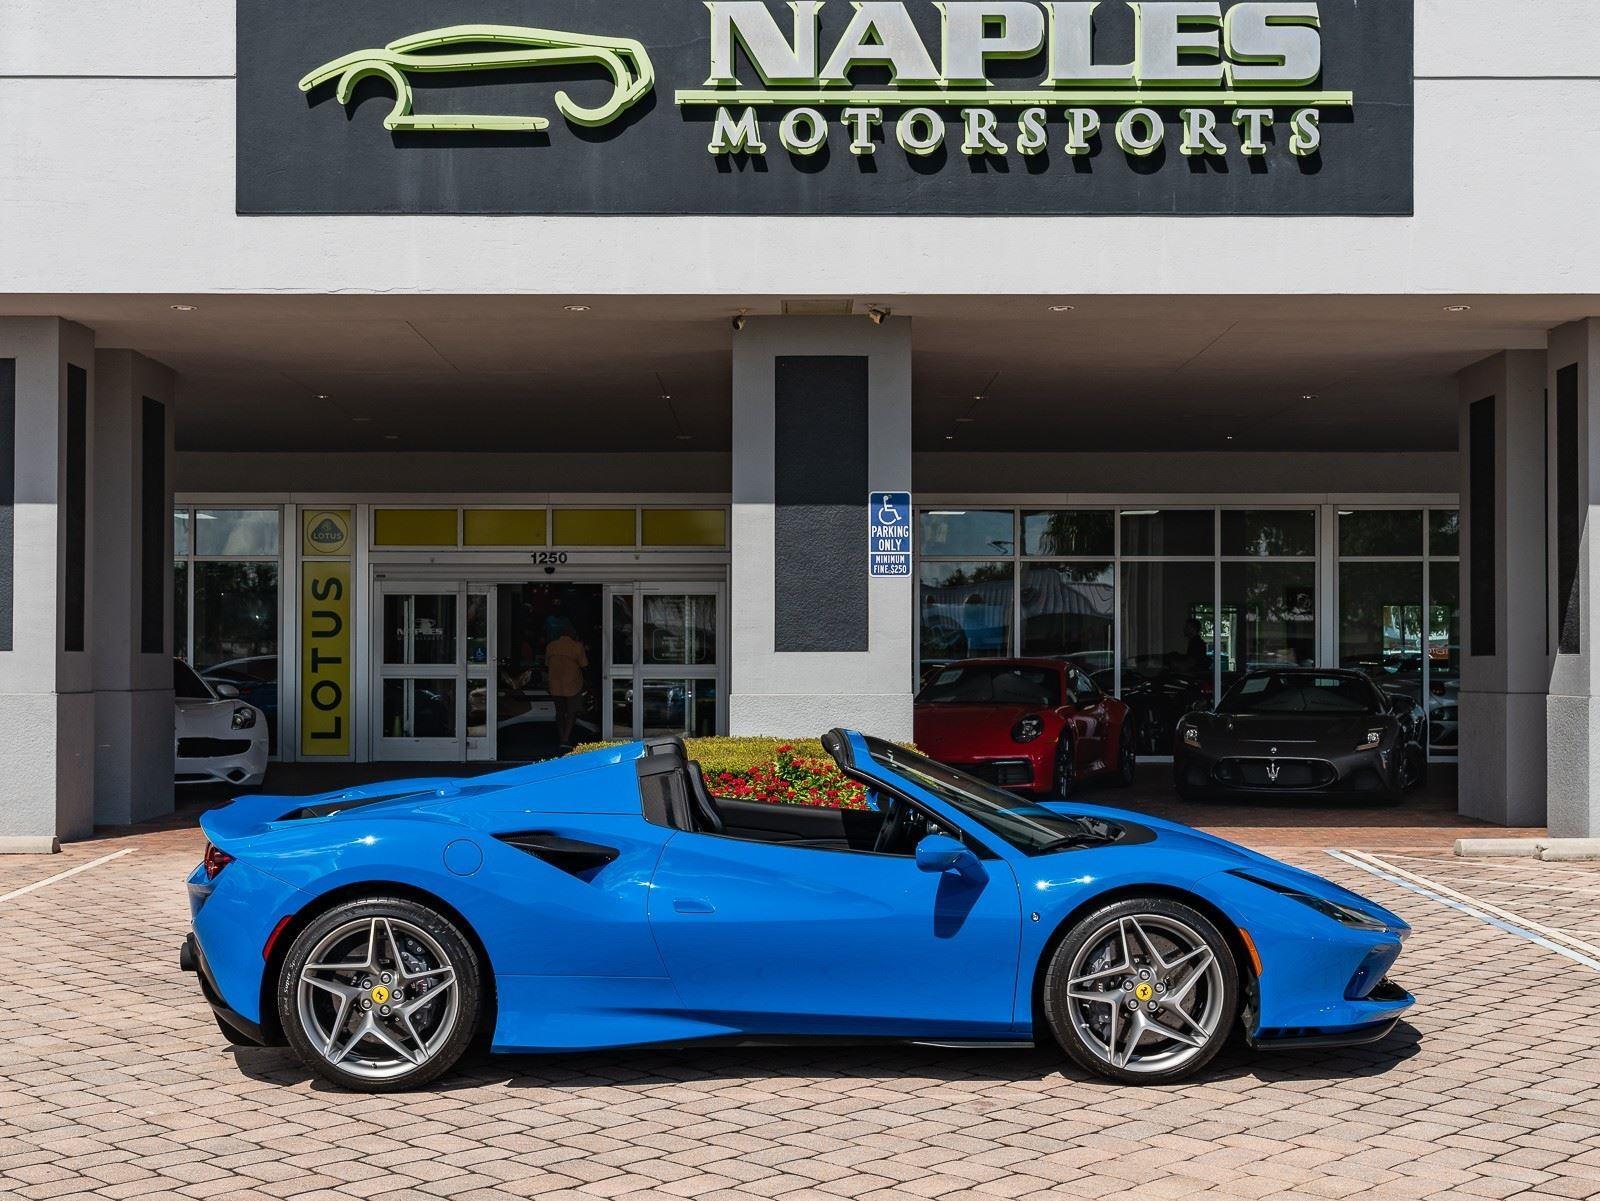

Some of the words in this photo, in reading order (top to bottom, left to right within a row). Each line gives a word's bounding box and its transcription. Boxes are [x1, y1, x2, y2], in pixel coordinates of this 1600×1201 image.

[703, 1, 1321, 87] NAPLES
[708, 106, 1322, 157] MOTORSPORTS
[313, 532, 342, 540] LOTUS
[871, 525, 909, 538] PARKING
[878, 538, 902, 551] ONLY
[530, 551, 568, 564] 1250
[875, 554, 905, 564] MINIMUM
[873, 564, 889, 574] FINE
[890, 564, 907, 574] $250
[311, 577, 342, 739] LOTUS
